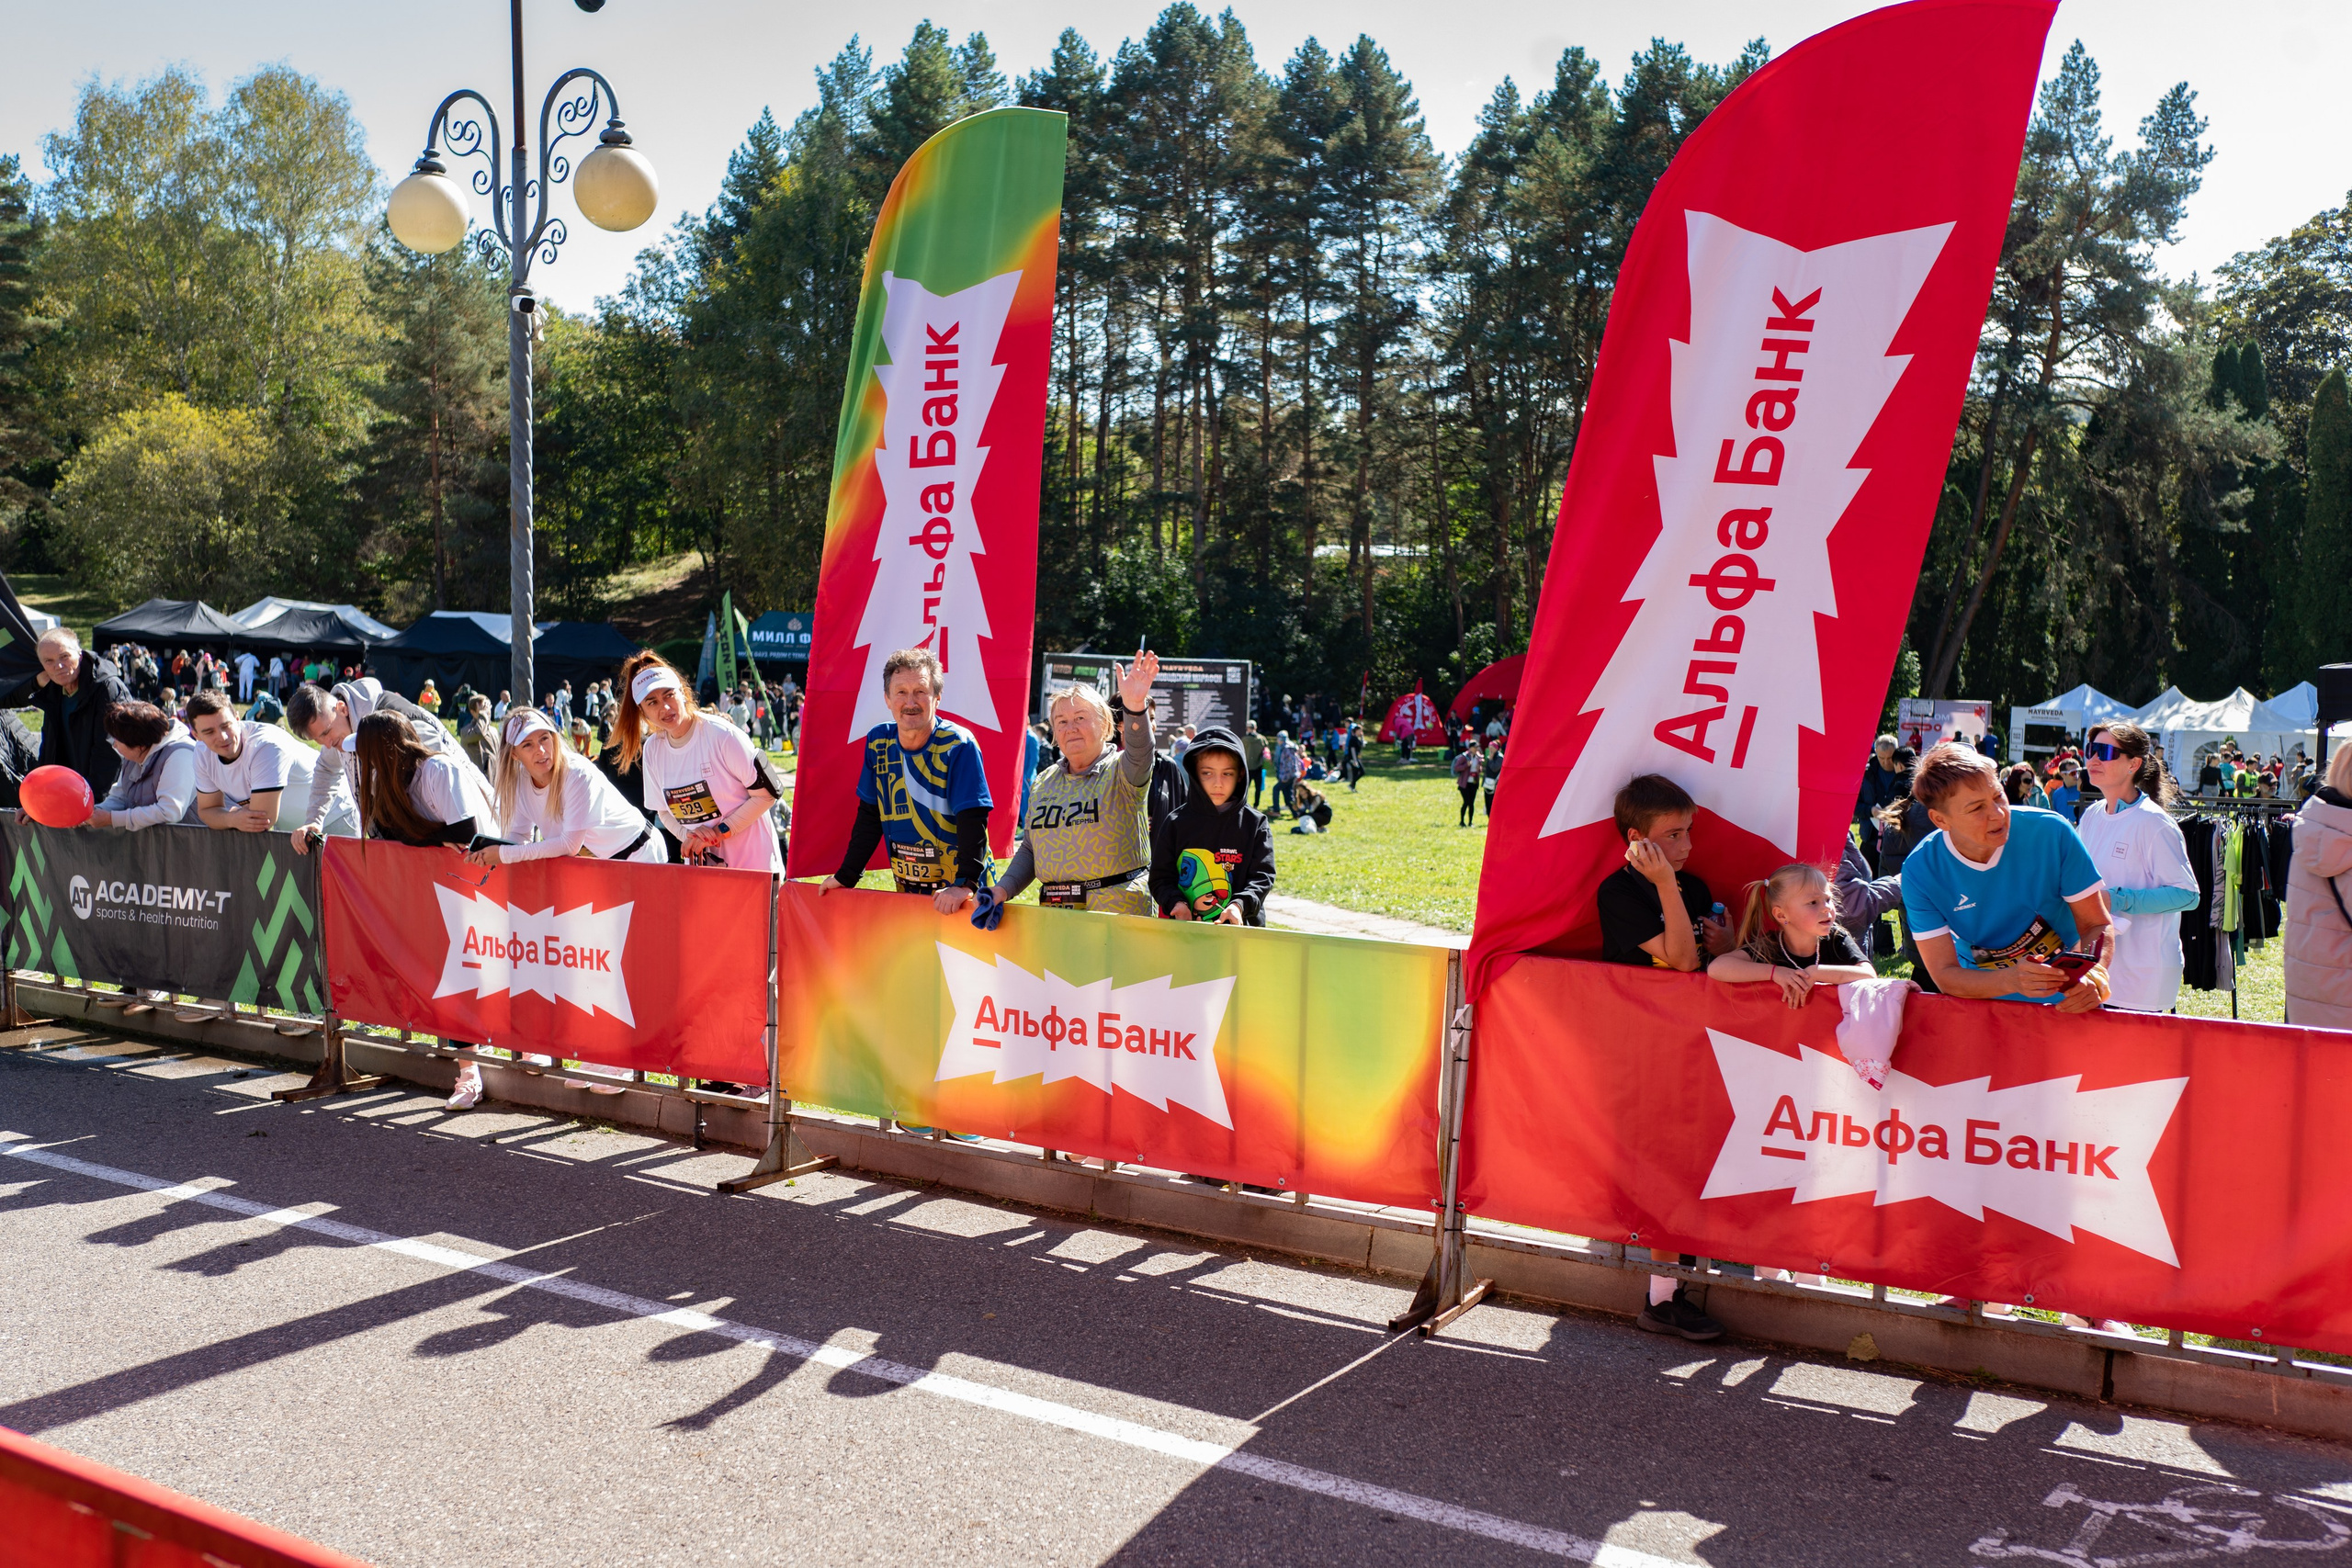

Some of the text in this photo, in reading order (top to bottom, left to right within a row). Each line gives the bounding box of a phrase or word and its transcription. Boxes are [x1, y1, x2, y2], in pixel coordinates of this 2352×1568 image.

[910, 320, 959, 469] Банк
[1654, 285, 1823, 766] Альфа Банк
[752, 631, 795, 644] МИЛЛ
[679, 801, 704, 816] 529
[1031, 797, 1100, 829] 20:24
[1071, 818, 1094, 826] ПЕРМЬ
[897, 861, 931, 878] 5162
[1214, 852, 1243, 863] STARS
[95, 880, 232, 914] ACADEMY-T
[96, 907, 219, 931] sports & health nutrition
[462, 925, 611, 973] Альфа Банк
[973, 995, 1197, 1061] Альфа Банк
[1761, 1095, 2120, 1180] Альфа Банк
